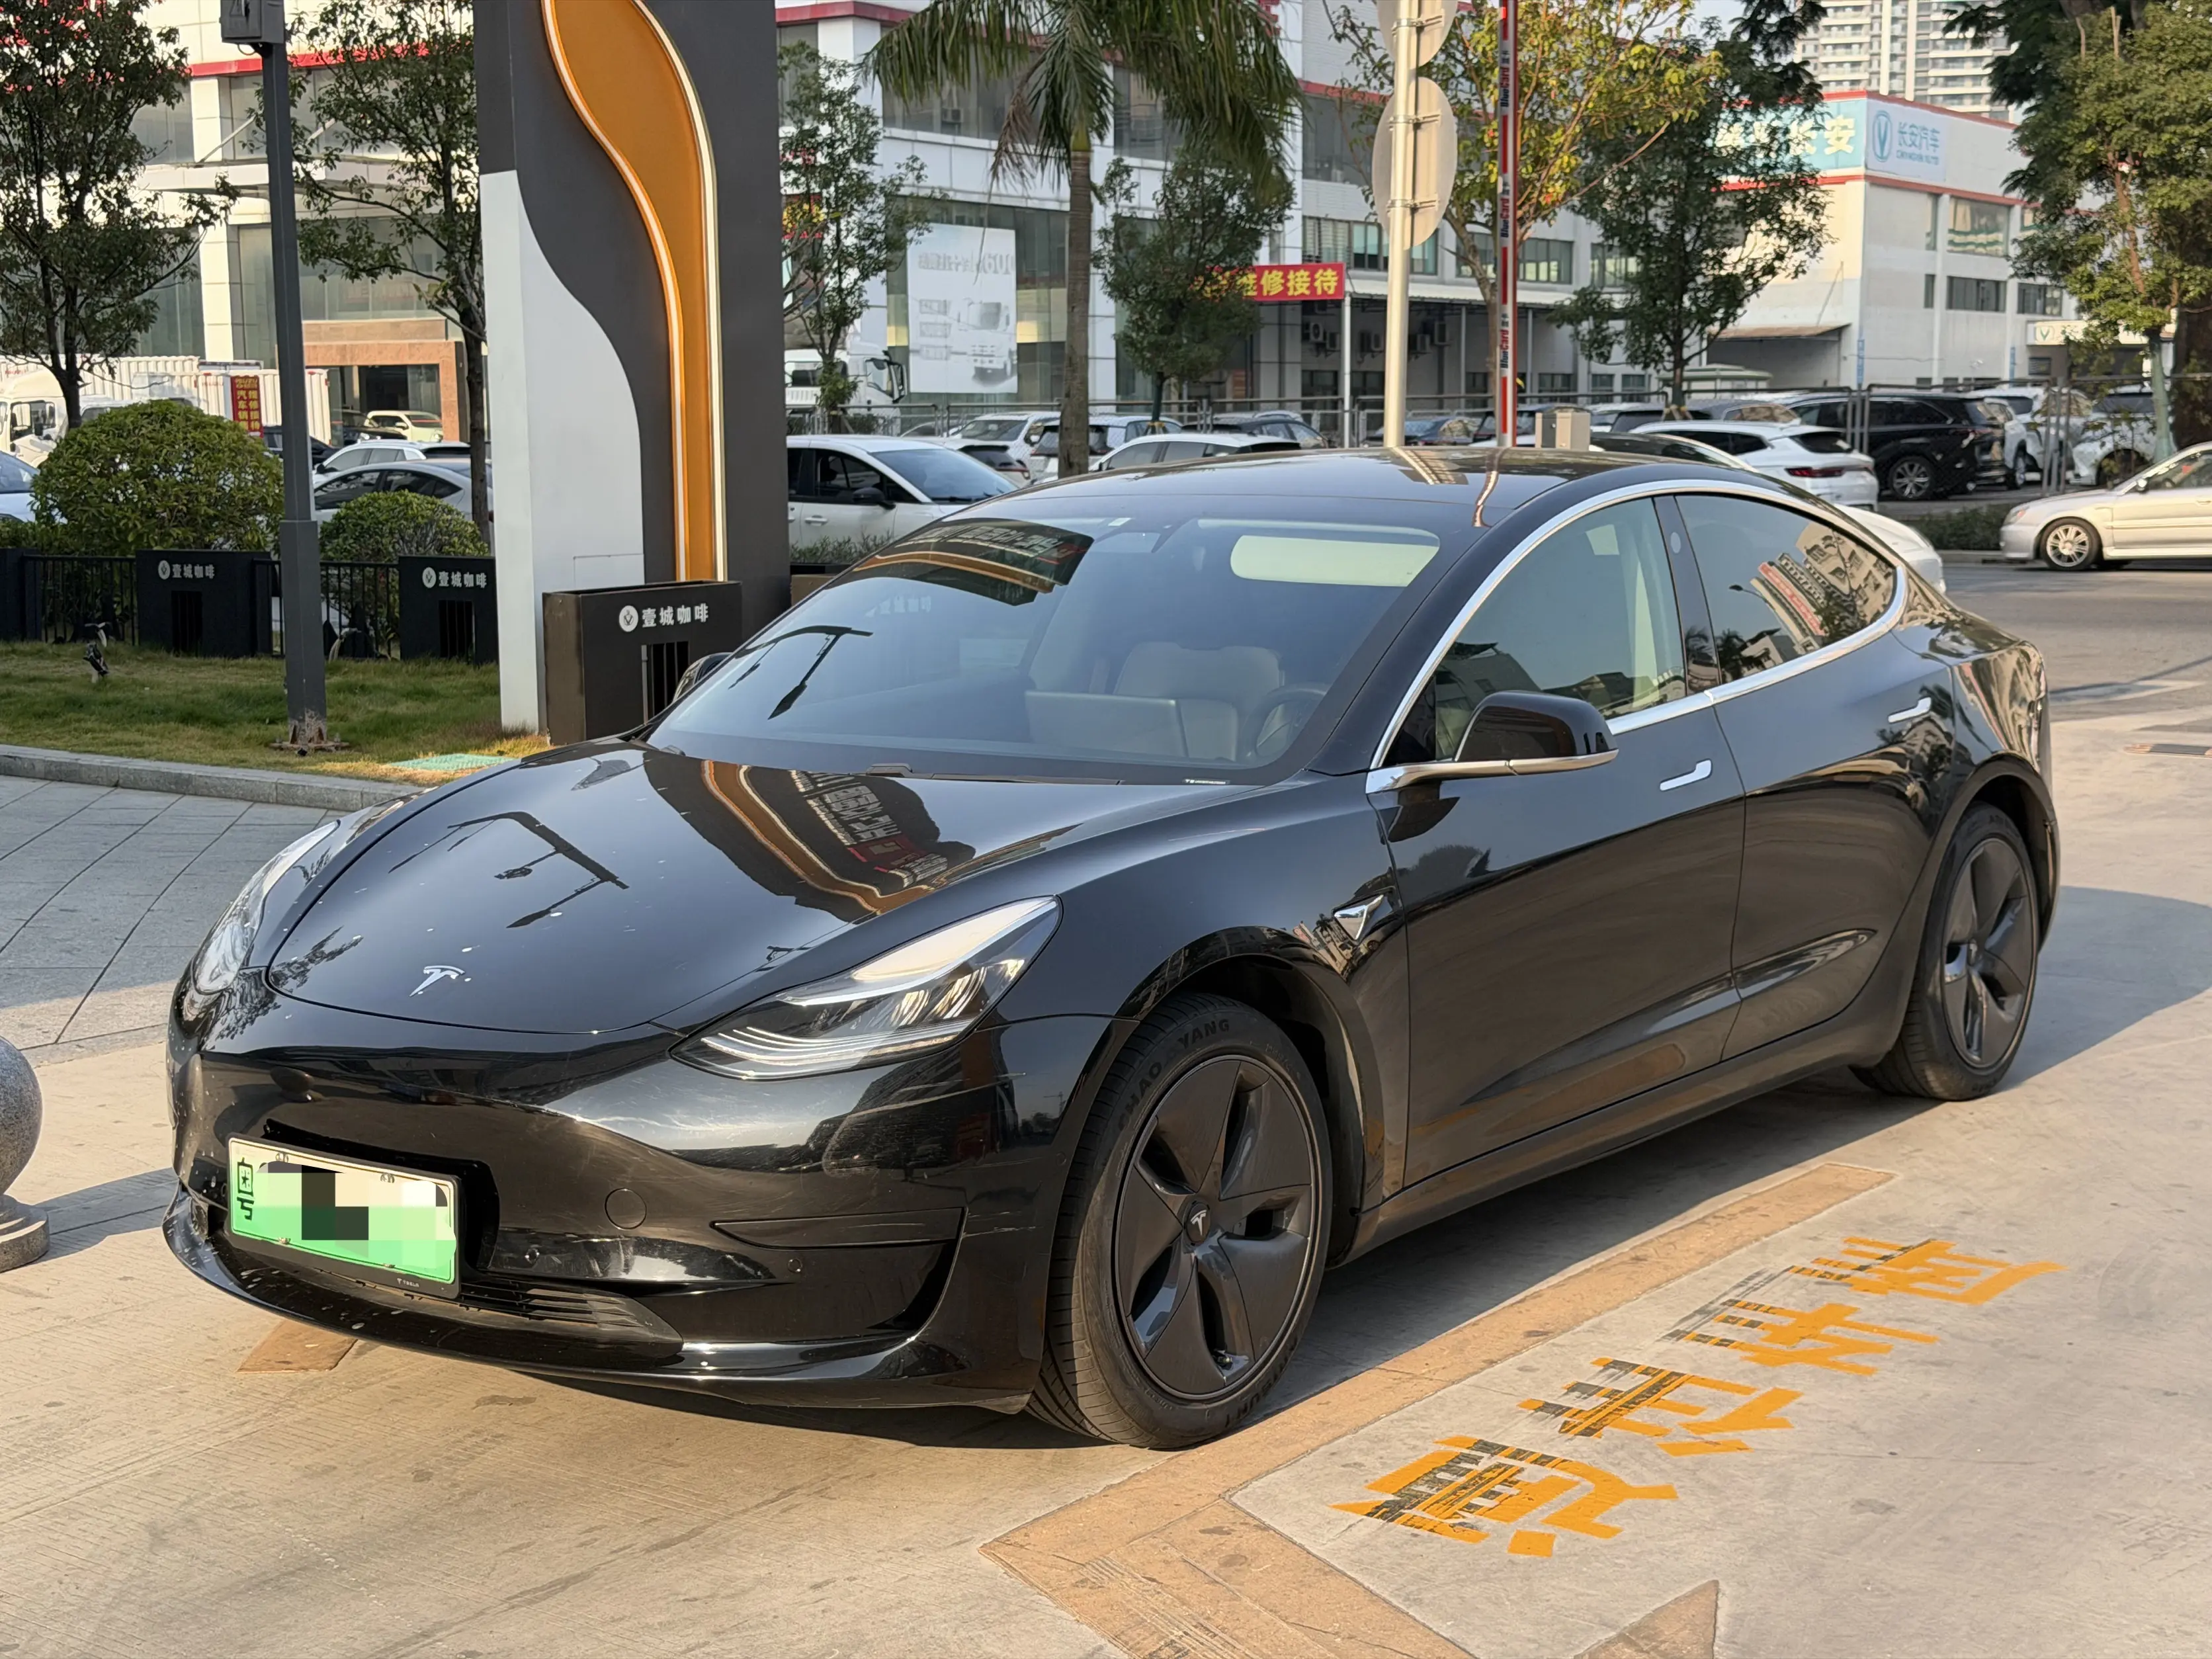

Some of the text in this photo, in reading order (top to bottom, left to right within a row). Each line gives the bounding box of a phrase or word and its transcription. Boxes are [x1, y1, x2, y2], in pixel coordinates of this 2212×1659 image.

[1898, 122, 1941, 152] 长安汽车
[1500, 198, 1510, 238] BlueCard
[1500, 329, 1509, 369] BlueCard
[172, 564, 215, 579] 壹城咖啡
[439, 571, 488, 589] 壹城咖啡
[642, 603, 709, 628] 壹城咖啡
[1118, 1019, 1230, 1130] CHAO YANG
[1329, 1236, 2070, 1558] 通往车库
